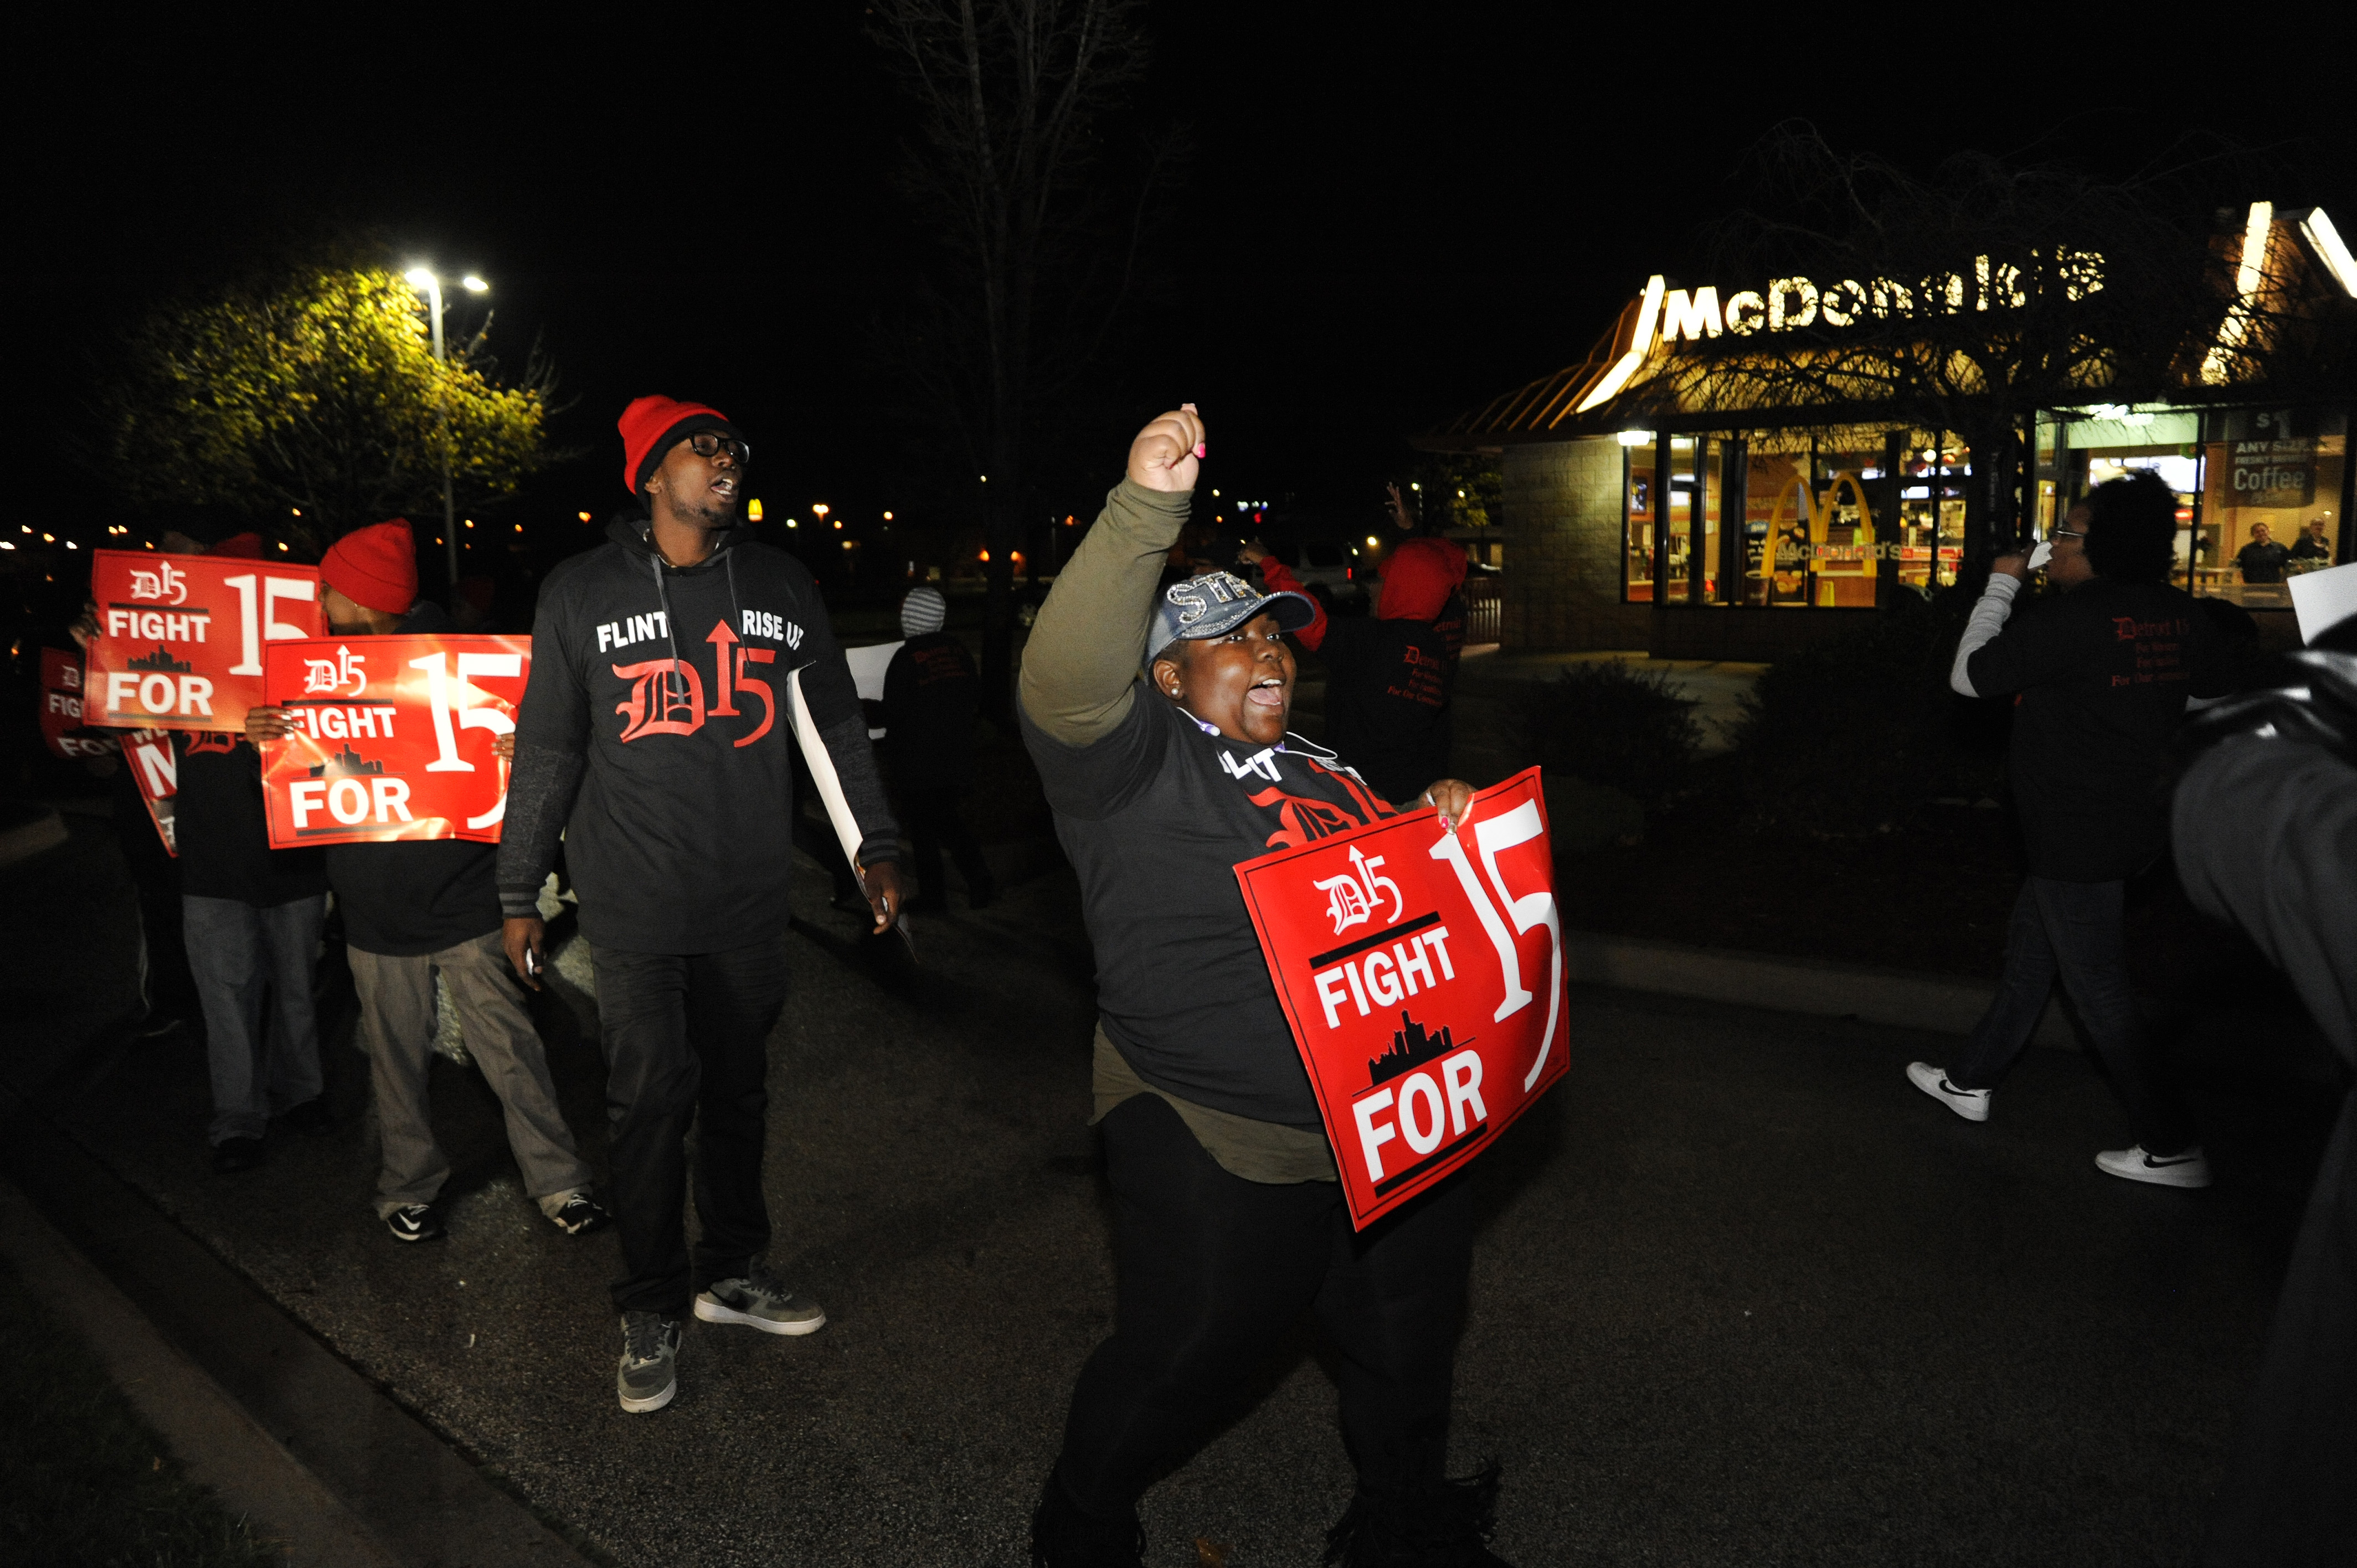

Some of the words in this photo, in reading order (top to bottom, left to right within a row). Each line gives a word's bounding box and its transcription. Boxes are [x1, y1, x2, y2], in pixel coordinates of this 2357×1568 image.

[2236, 442, 2269, 454] ANY
[2234, 467, 2305, 491] Coffee
[1777, 541, 1902, 561] McDonald's
[107, 610, 212, 643] FIGHT
[596, 610, 668, 653] FLINT
[743, 610, 784, 641] RISE
[107, 672, 214, 716] FOR
[303, 644, 367, 697] D15
[612, 618, 776, 749] D15
[49, 693, 81, 718] FIG
[409, 652, 522, 829] 15
[289, 777, 414, 828] FOR
[1313, 845, 1403, 935] D15
[1429, 798, 1562, 1094] 15
[1314, 926, 1455, 1030] FIGHT
[1352, 1049, 1488, 1183] FOR
